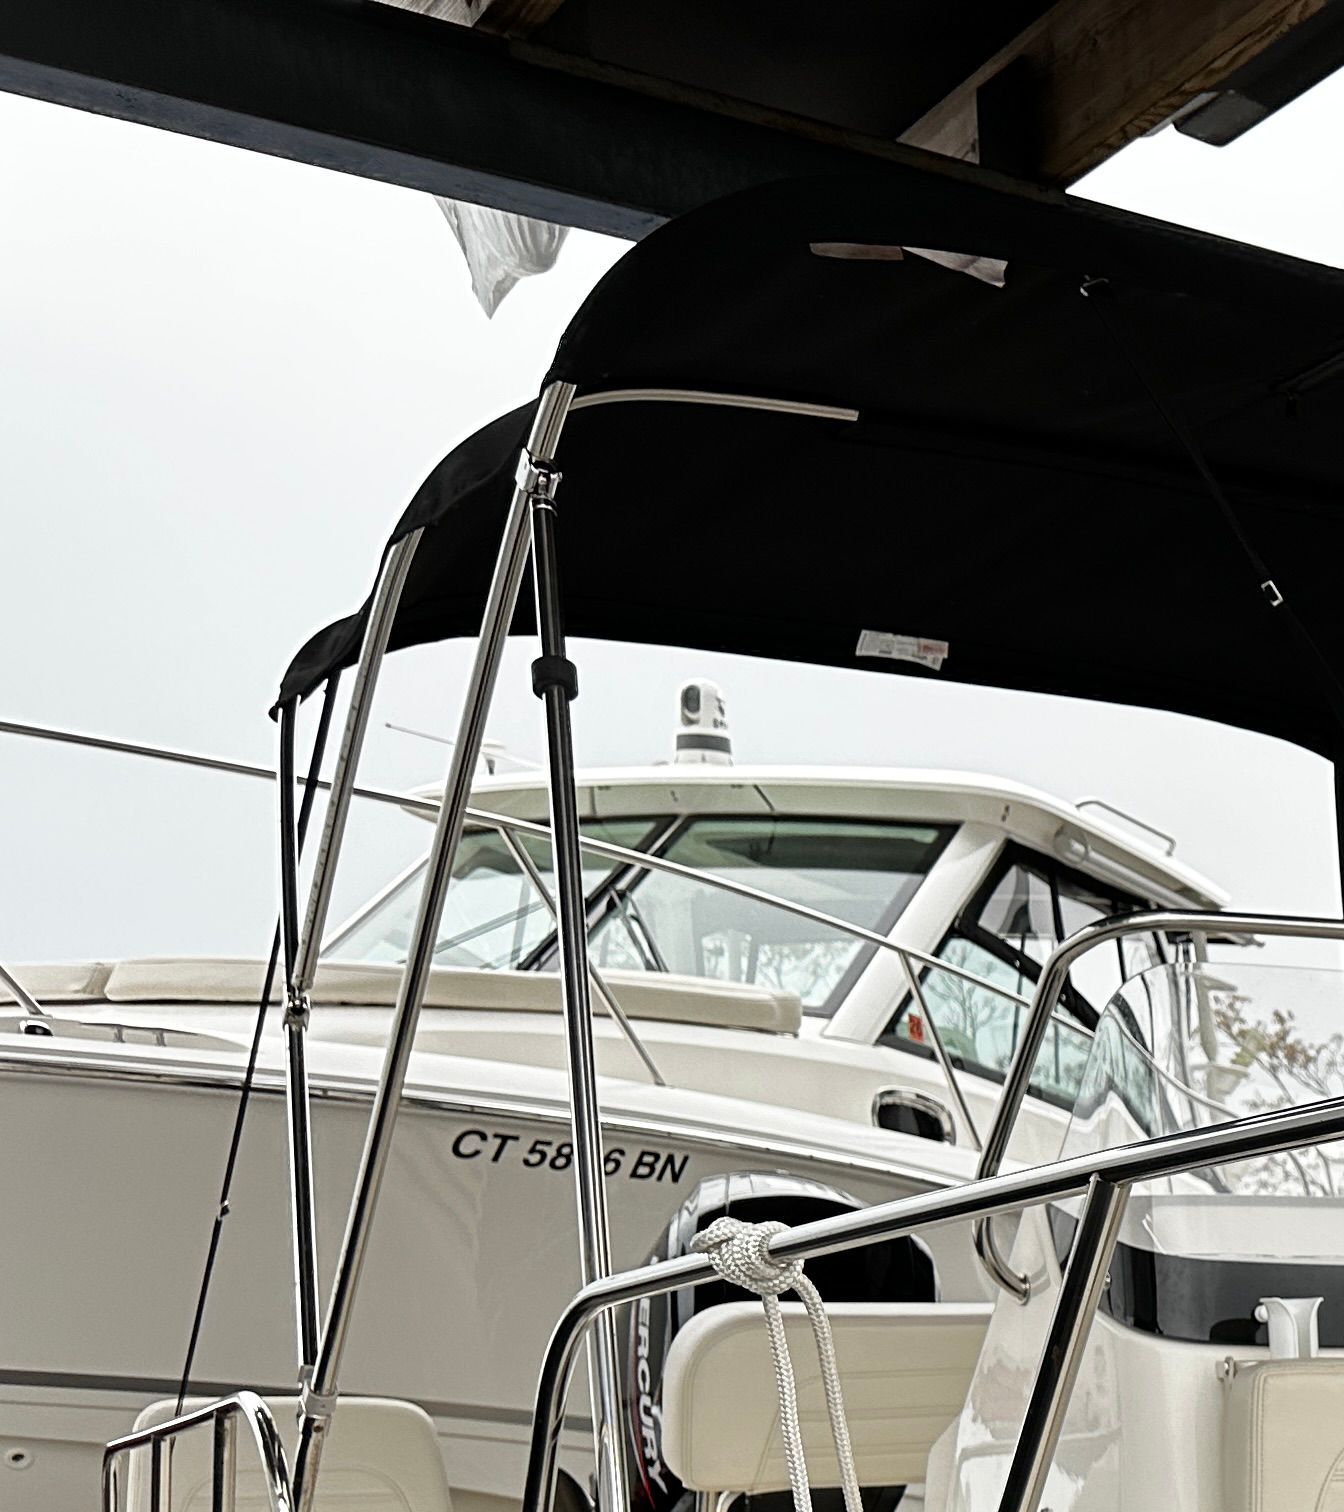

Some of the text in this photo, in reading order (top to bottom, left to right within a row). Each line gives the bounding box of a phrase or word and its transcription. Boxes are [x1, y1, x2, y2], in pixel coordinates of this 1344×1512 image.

[452, 1129, 689, 1184] CT 586 BN
[637, 1255, 669, 1495] ERCURY
